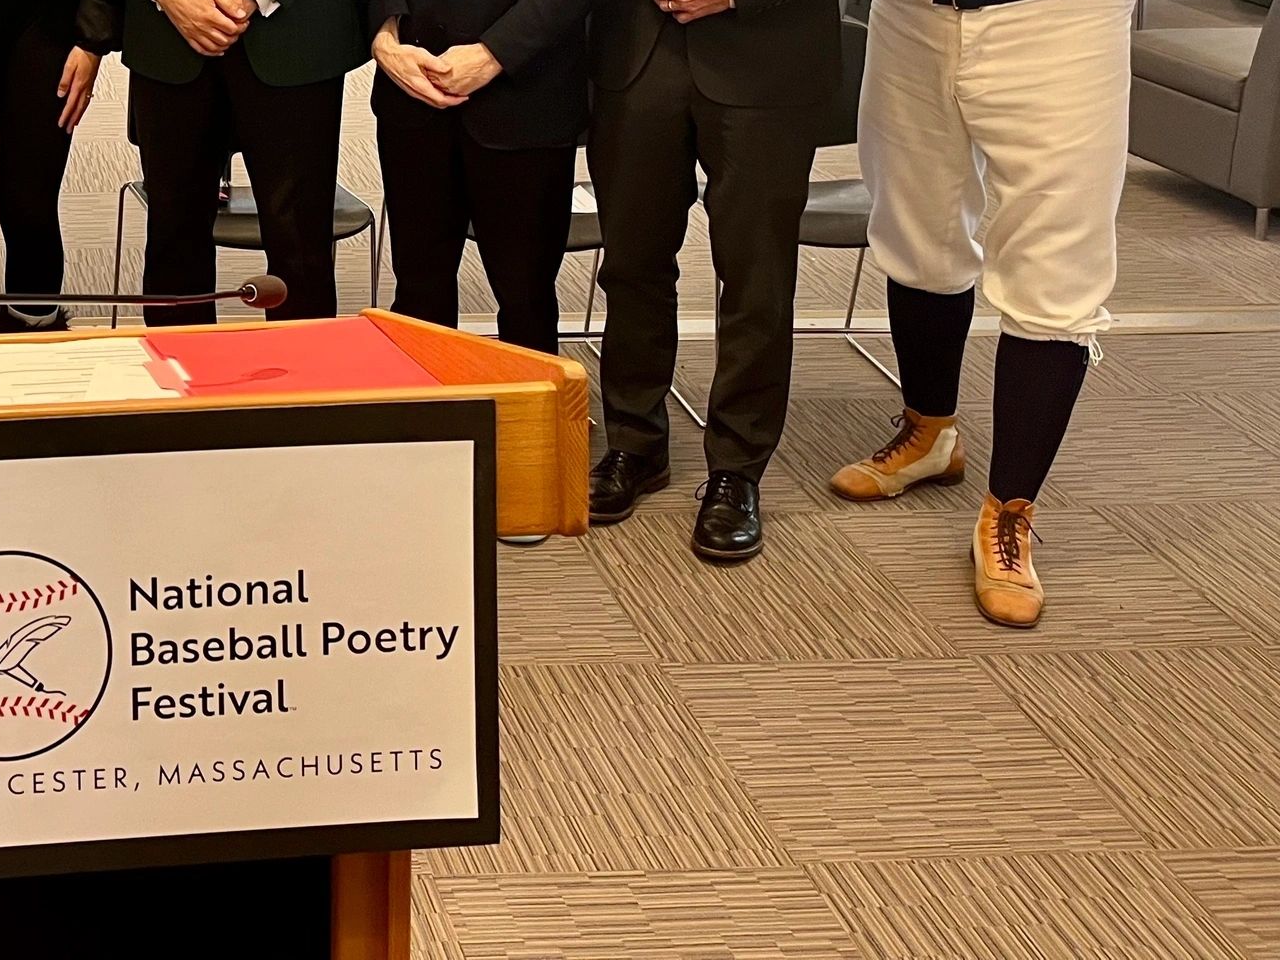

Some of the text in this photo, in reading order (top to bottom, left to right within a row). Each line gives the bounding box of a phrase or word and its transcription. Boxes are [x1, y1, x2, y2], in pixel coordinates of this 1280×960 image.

[129, 569, 309, 612] National
[130, 621, 460, 666] Baseball Poetry
[131, 679, 289, 721] Festival
[158, 748, 443, 786] MASSACHUSETTS
